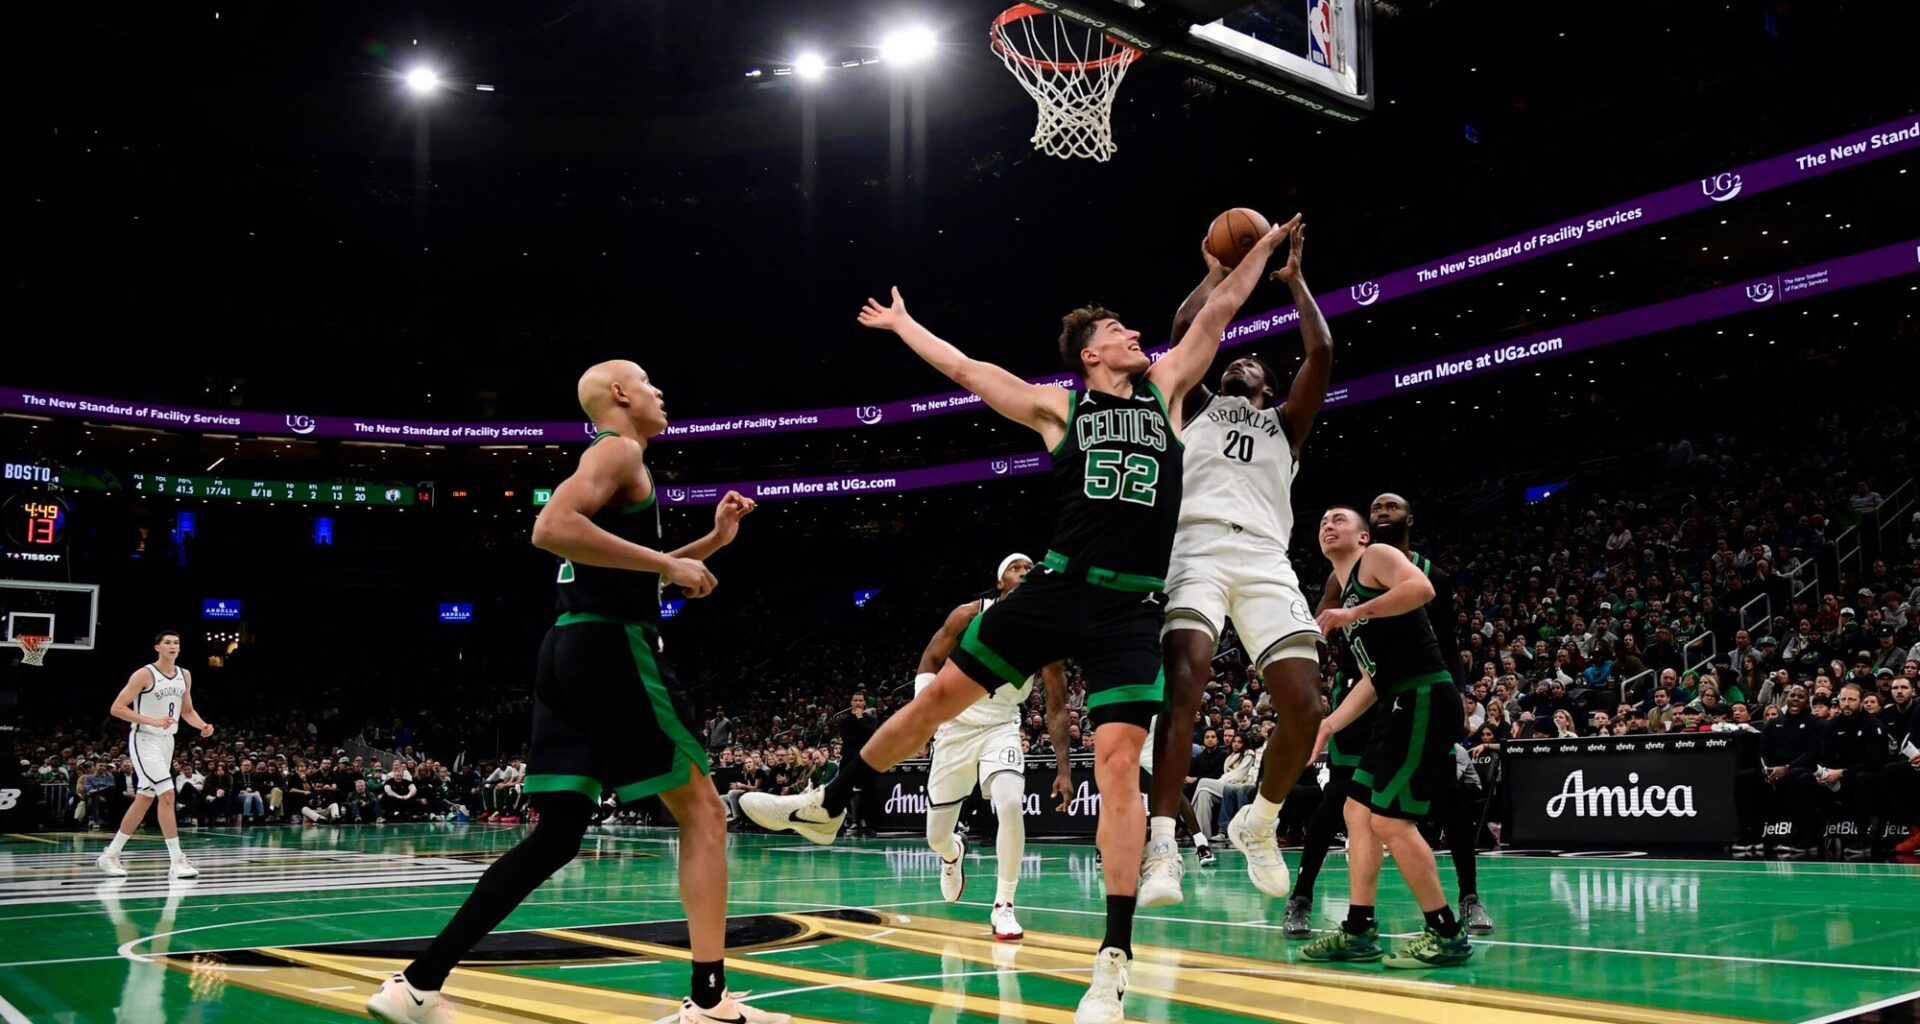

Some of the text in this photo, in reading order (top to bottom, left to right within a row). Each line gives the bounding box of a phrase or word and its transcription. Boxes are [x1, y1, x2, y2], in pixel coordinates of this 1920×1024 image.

[1796, 122, 1920, 170] The New Stand
[1701, 172, 1743, 196] UG2
[1416, 206, 1643, 283] The New Standard of Facility Services
[1350, 281, 1380, 300] UG2
[1746, 283, 1774, 298] UG2
[1227, 327, 1237, 340] of
[1238, 318, 1271, 337] Facility
[1272, 309, 1300, 326] Servic
[1395, 336, 1563, 388] Learn More at UG2.com
[22, 394, 241, 425] The New Standard of Facility Services
[856, 405, 883, 420] UG2
[911, 394, 981, 413] The New Standa
[286, 414, 316, 428] UG2
[354, 422, 544, 439] The New Standard of Facility Services
[667, 426, 688, 435] New
[689, 421, 731, 433] Standard
[732, 420, 743, 430] of
[744, 416, 777, 429] Facility
[778, 416, 818, 426] Services
[1076, 408, 1167, 452] CELTICS
[1207, 406, 1279, 438] BROOKLYN
[1223, 430, 1254, 462] 20
[5, 463, 59, 483] BOSTO
[1083, 448, 1159, 507] 52
[135, 482, 366, 501] 4 5 41.5 17/41 8/18 2 2 13 20
[418, 492, 429, 500] 14
[757, 477, 897, 496] Learn More at UG2.com
[25, 502, 58, 519] 4:49
[27, 518, 54, 544] 13
[21, 552, 60, 562] TISSOT
[168, 702, 175, 718] 8
[1533, 744, 1551, 754] xfinity
[1560, 744, 1578, 753] xfinity
[1587, 743, 1606, 752] xfinity
[1616, 742, 1635, 751] xfinity
[1645, 740, 1665, 750] xfinity
[1675, 739, 1695, 749] xfinity
[1706, 738, 1727, 748] xfinity
[1008, 749, 1016, 763] B
[884, 783, 928, 814] Ami
[1546, 769, 1697, 818] Amica
[1762, 822, 1792, 837] jetBl
